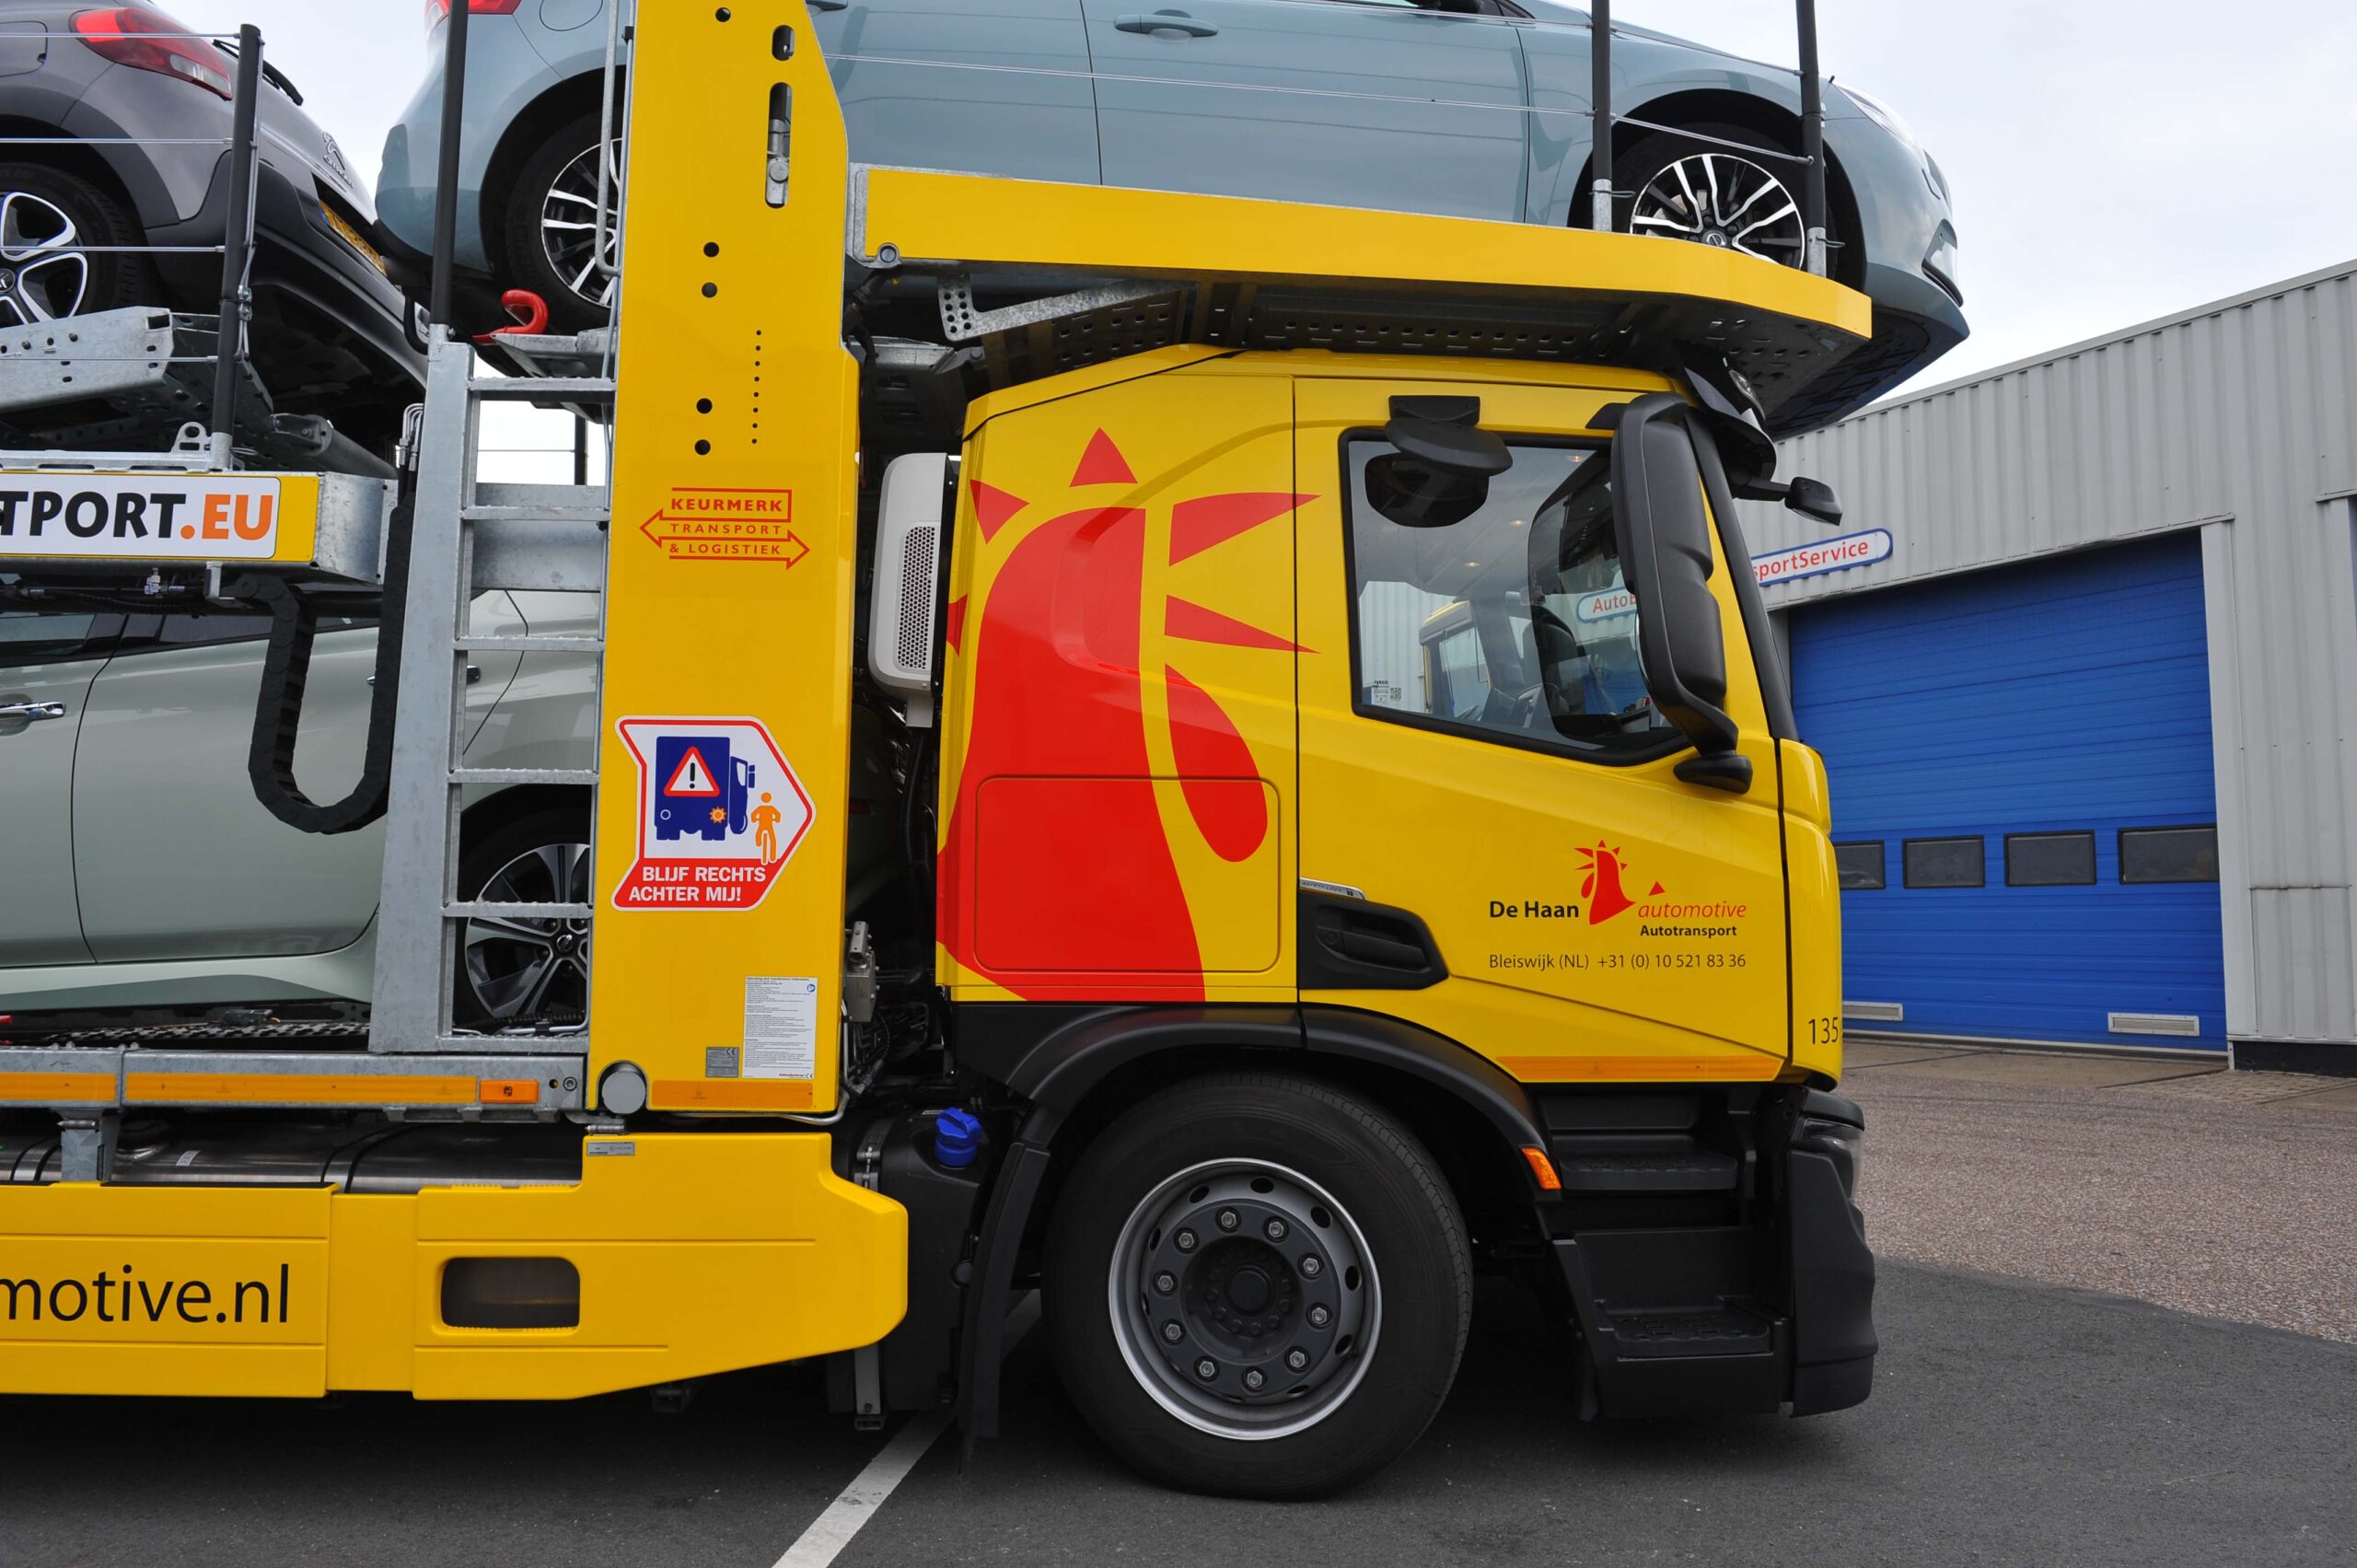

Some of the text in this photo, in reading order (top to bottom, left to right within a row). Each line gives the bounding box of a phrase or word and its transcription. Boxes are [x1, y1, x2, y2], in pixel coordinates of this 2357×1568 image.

[670, 498, 783, 512] KEURMERK
[0, 490, 273, 540] TPORT.EU
[670, 523, 781, 535] TRANSPORT
[669, 543, 781, 554] & LOGISTIEK
[642, 866, 766, 882] BLIJF RECHTS
[628, 886, 741, 901] ACHTER MIJ!
[1490, 900, 1747, 918] De Haan automotive
[1640, 924, 1737, 938] Autotransport
[1489, 954, 1747, 971] Bleiswijk (NL) +31 (0) 10 521 83 36
[1808, 1016, 1839, 1045] 135
[0, 1263, 289, 1323] motive.nl
